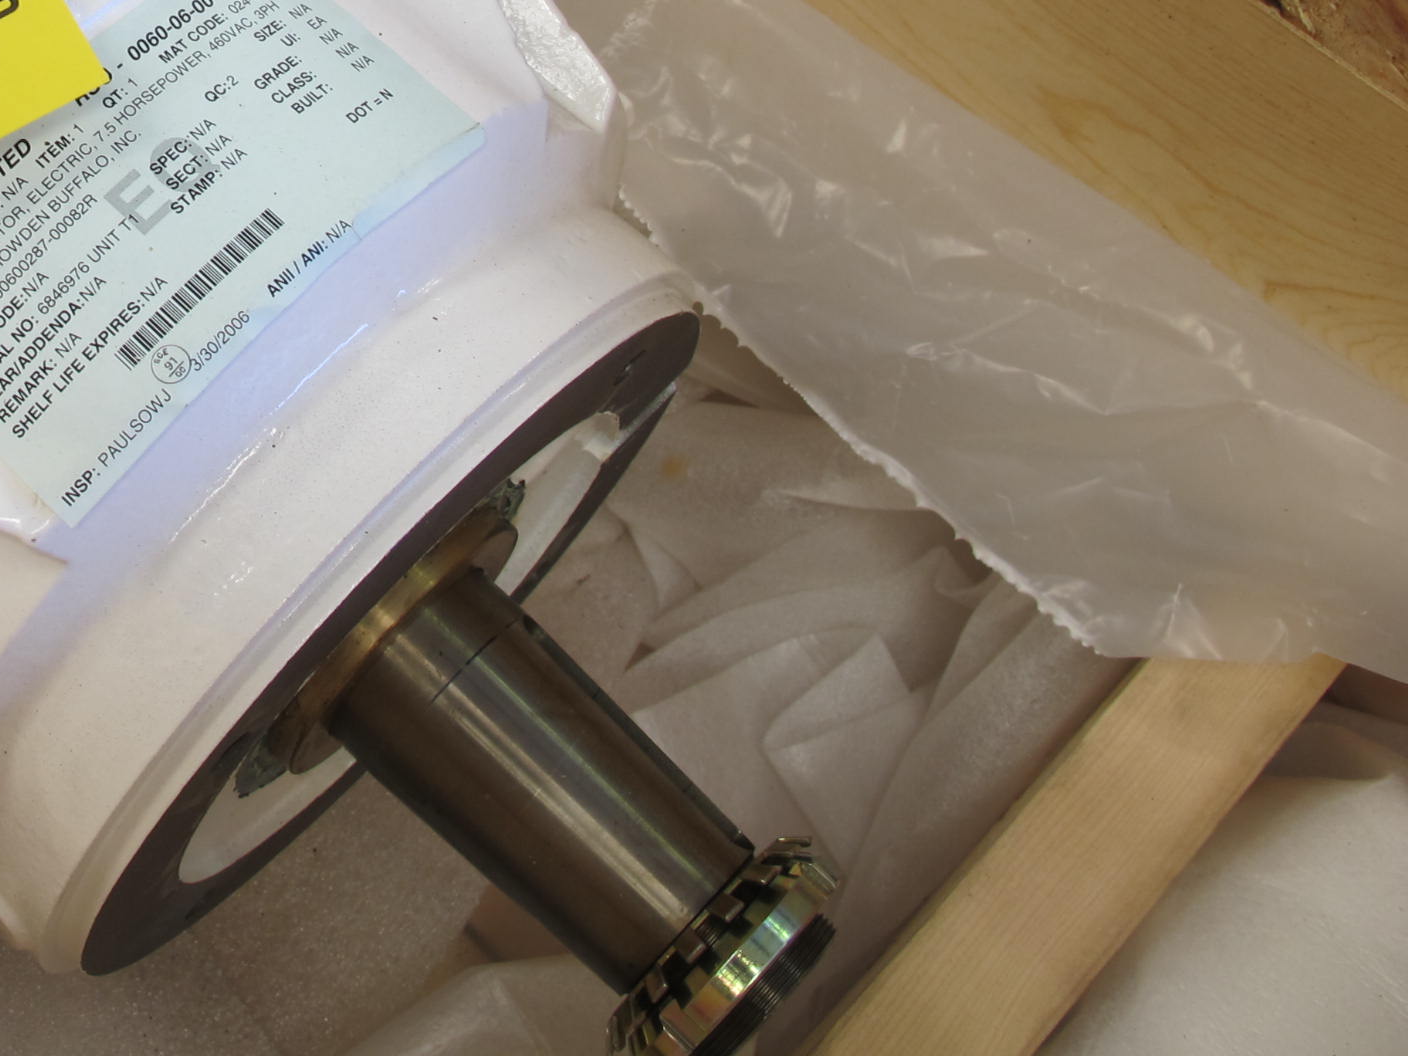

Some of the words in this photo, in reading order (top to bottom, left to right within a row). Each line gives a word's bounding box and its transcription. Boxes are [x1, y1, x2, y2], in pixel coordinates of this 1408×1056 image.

[158, 38, 189, 65] MAT
[186, 12, 229, 42] CODE:
[253, 19, 287, 43] SIZE:
[288, 3, 313, 20] N/A
[280, 32, 301, 47] UI:
[306, 16, 327, 30] EA
[253, 55, 303, 91] GRADE:
[319, 28, 344, 46] N/A
[270, 70, 318, 104] CLASS:
[335, 42, 360, 59] N/A
[291, 83, 334, 115] BUILT:
[350, 54, 375, 73] N/A
[26, 143, 99, 205] ELECTRIC,
[94, 121, 117, 143] 7.5
[114, 49, 211, 126] HORSEPOWER,
[209, 16, 258, 52] 460VAC,
[257, 0, 280, 21] 3PH
[101, 87, 129, 109] QT:
[345, 101, 374, 125] DOT
[379, 87, 394, 100] N
[1, 176, 29, 202] N/A
[35, 133, 76, 170] ITEM:
[48, 153, 115, 214] BUFFALO,
[113, 129, 142, 155] INC.
[149, 135, 192, 175] SPEC:
[189, 119, 217, 141] N/A
[166, 153, 209, 191] SECT:
[205, 134, 232, 157] N/A
[104, 137, 221, 236] EQ
[170, 169, 224, 215] STAMP:
[220, 147, 248, 171] N/A
[325, 219, 352, 245] N/A
[10, 315, 40, 348] NO:
[37, 261, 91, 316] 6846976
[87, 229, 121, 264] UNIT
[118, 213, 139, 232] T1
[54, 331, 83, 359] N/A
[164, 357, 178, 371] 91
[189, 310, 251, 373] 3/30/2006
[12, 393, 55, 439] SHELF
[53, 358, 85, 393] LIFE
[61, 467, 101, 507] INSP:
[97, 389, 172, 468] PAULSOWJ
